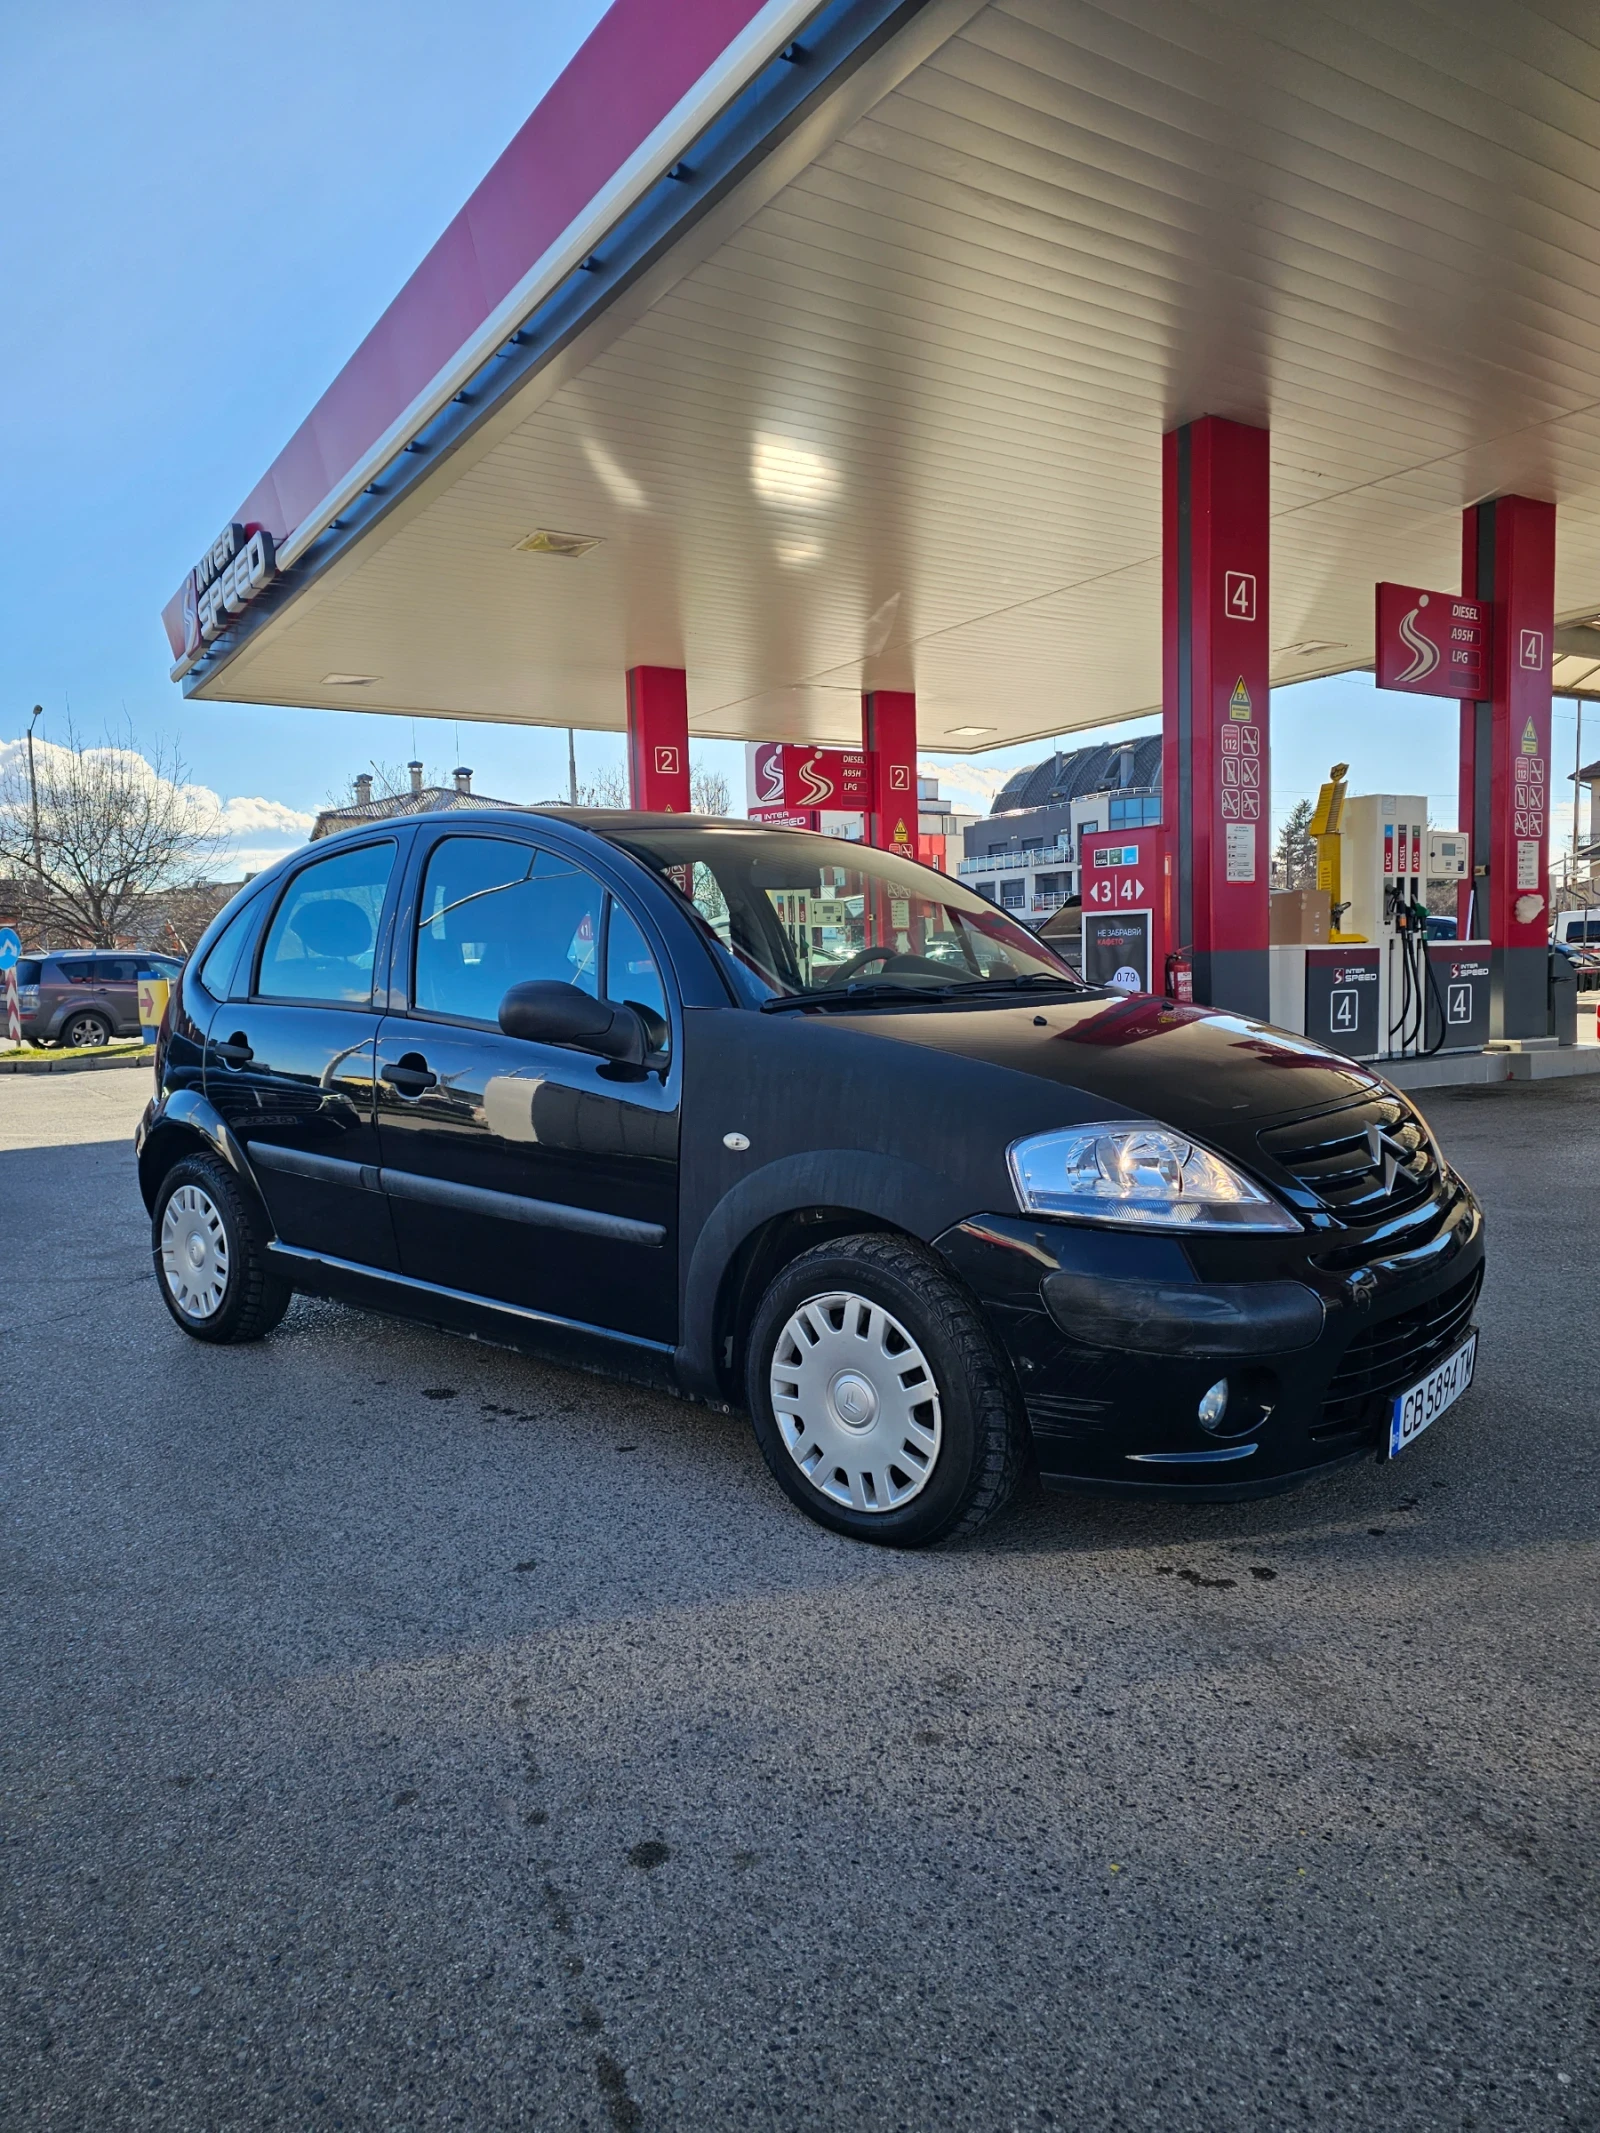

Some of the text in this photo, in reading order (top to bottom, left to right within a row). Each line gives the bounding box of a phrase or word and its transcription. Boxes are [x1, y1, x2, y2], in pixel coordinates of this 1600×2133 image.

[195, 523, 239, 593] INTER
[198, 530, 272, 641] SPEED
[1232, 580, 1248, 614] 4
[1452, 604, 1478, 620] DIESEL
[1451, 628, 1474, 642] A95H
[1452, 650, 1468, 664] LPG
[1525, 636, 1537, 664] 4
[1224, 739, 1237, 750] 112
[661, 750, 673, 770] 2
[842, 755, 864, 764] DIESEL
[842, 770, 862, 778] A95H
[894, 770, 904, 787] 2
[764, 811, 789, 820] INTER
[1101, 879, 1133, 902] 3 4
[1108, 927, 1142, 936] ЗАБРАВЯЙ
[1345, 974, 1376, 982] SPEED
[1460, 968, 1488, 976] SPEED
[1337, 996, 1352, 1026] 4
[1453, 990, 1466, 1018] 4
